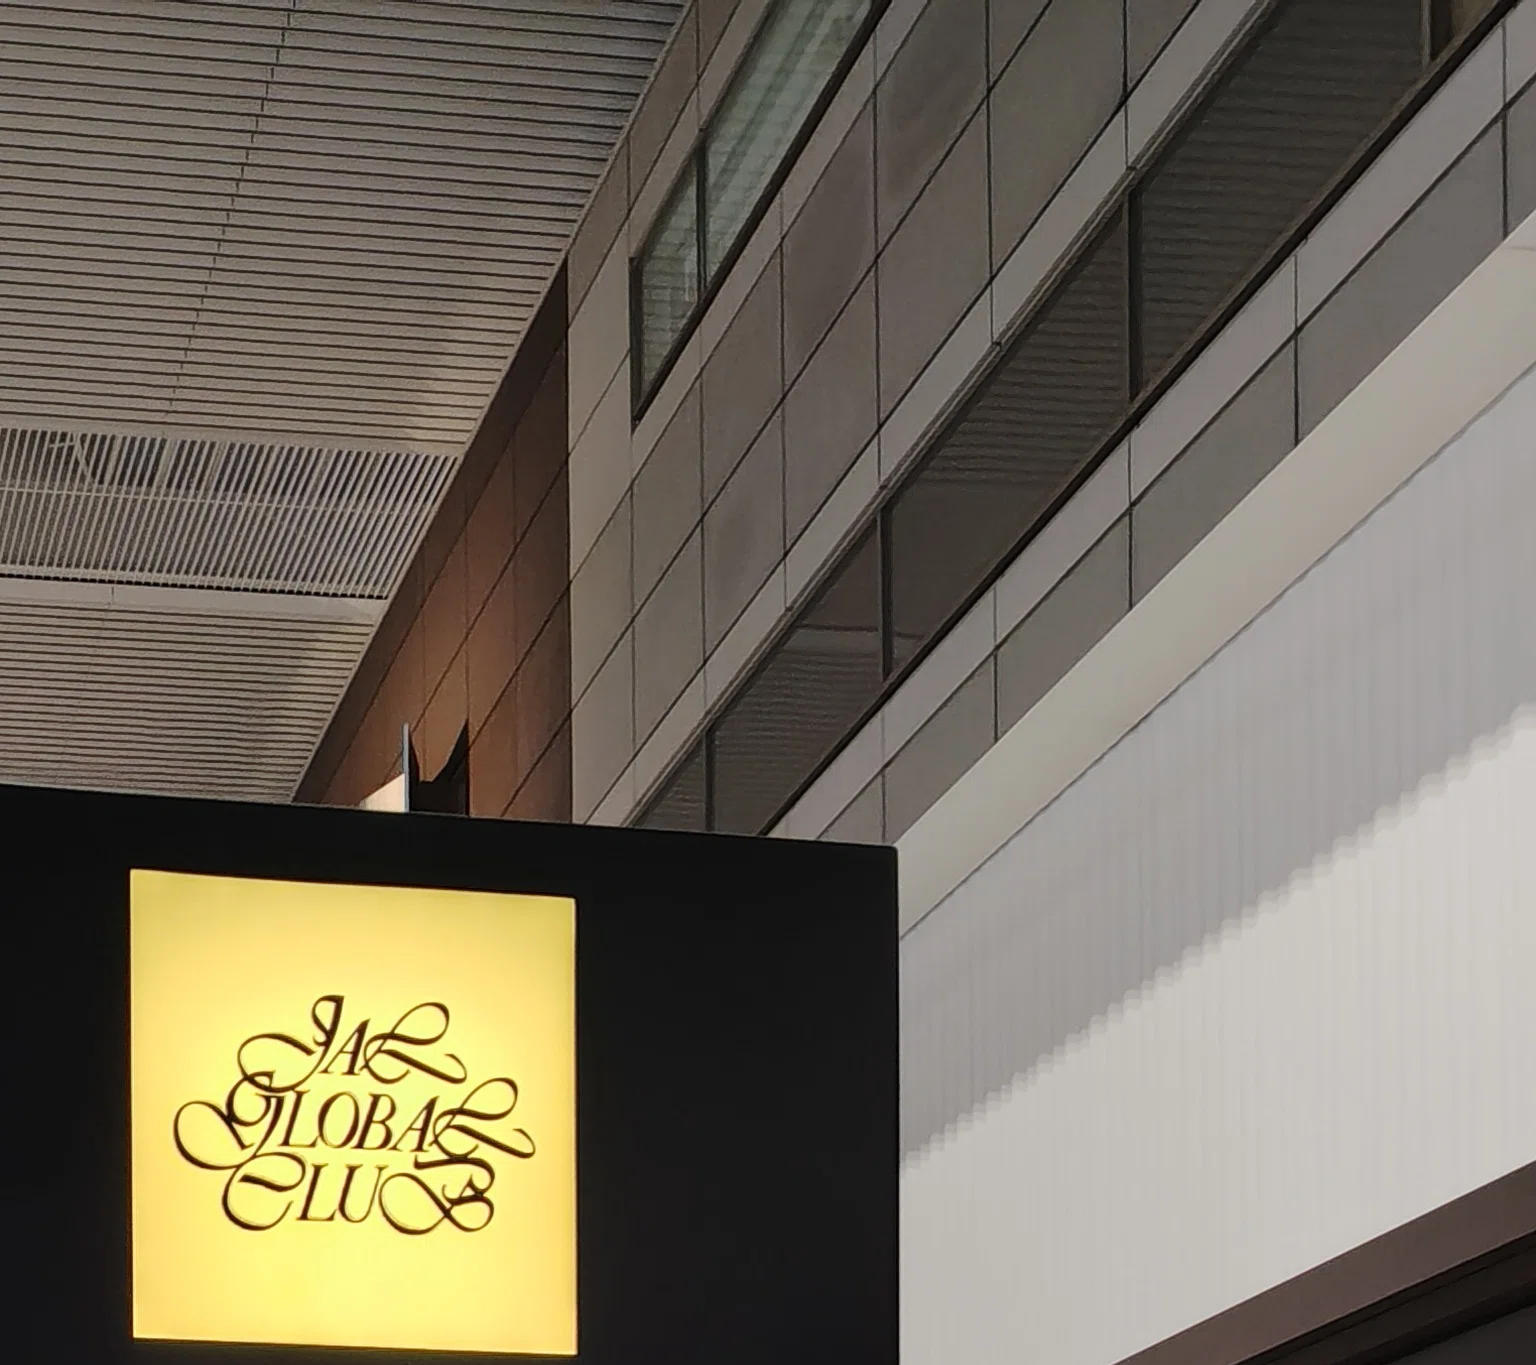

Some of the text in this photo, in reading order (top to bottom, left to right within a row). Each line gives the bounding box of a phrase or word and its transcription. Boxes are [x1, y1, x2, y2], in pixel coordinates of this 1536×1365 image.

[237, 994, 468, 1093] JAL
[173, 1071, 537, 1171] GLOBAL
[221, 1152, 496, 1236] CLUB
